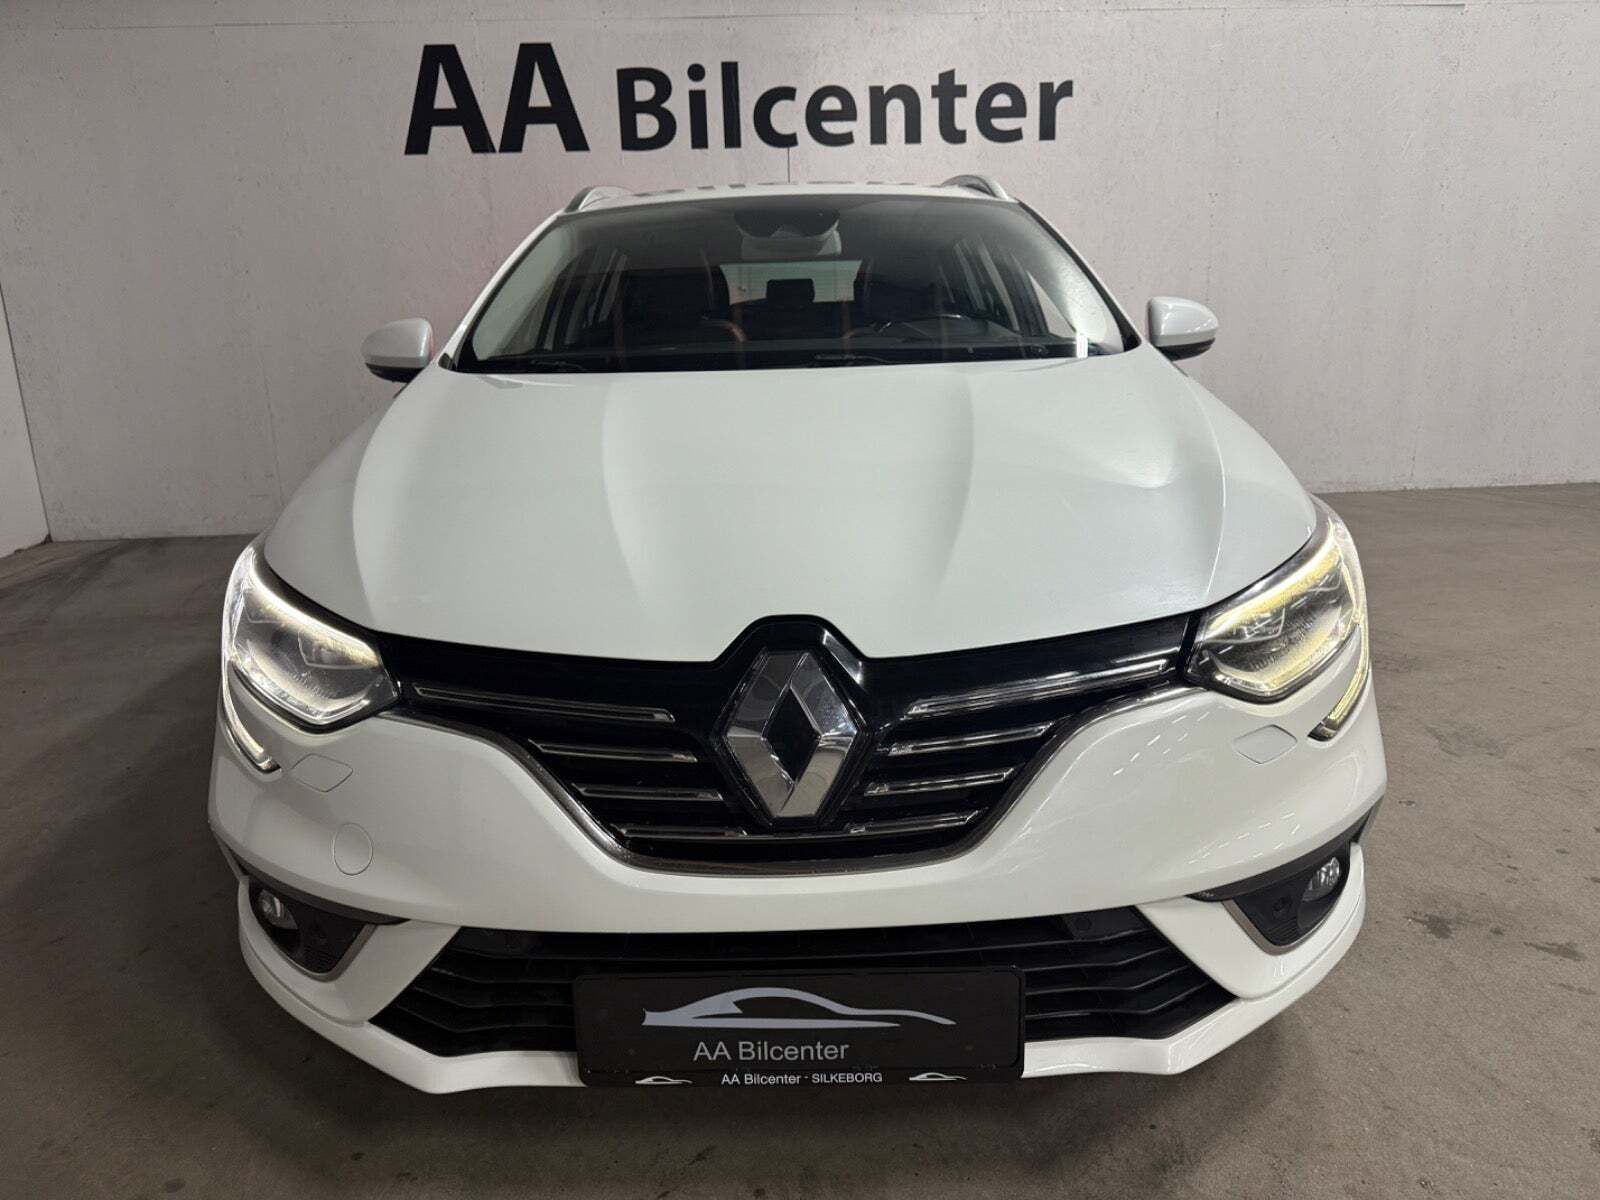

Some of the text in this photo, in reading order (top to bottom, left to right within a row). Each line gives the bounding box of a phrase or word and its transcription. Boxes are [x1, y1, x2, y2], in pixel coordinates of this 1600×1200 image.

[404, 43, 1073, 155] AA Bilcenter
[693, 1040, 849, 1061] AA Bilcenter
[721, 1073, 740, 1085] AA
[744, 1073, 801, 1085] Bilcenter
[811, 1072, 883, 1083] SILKEBORG
